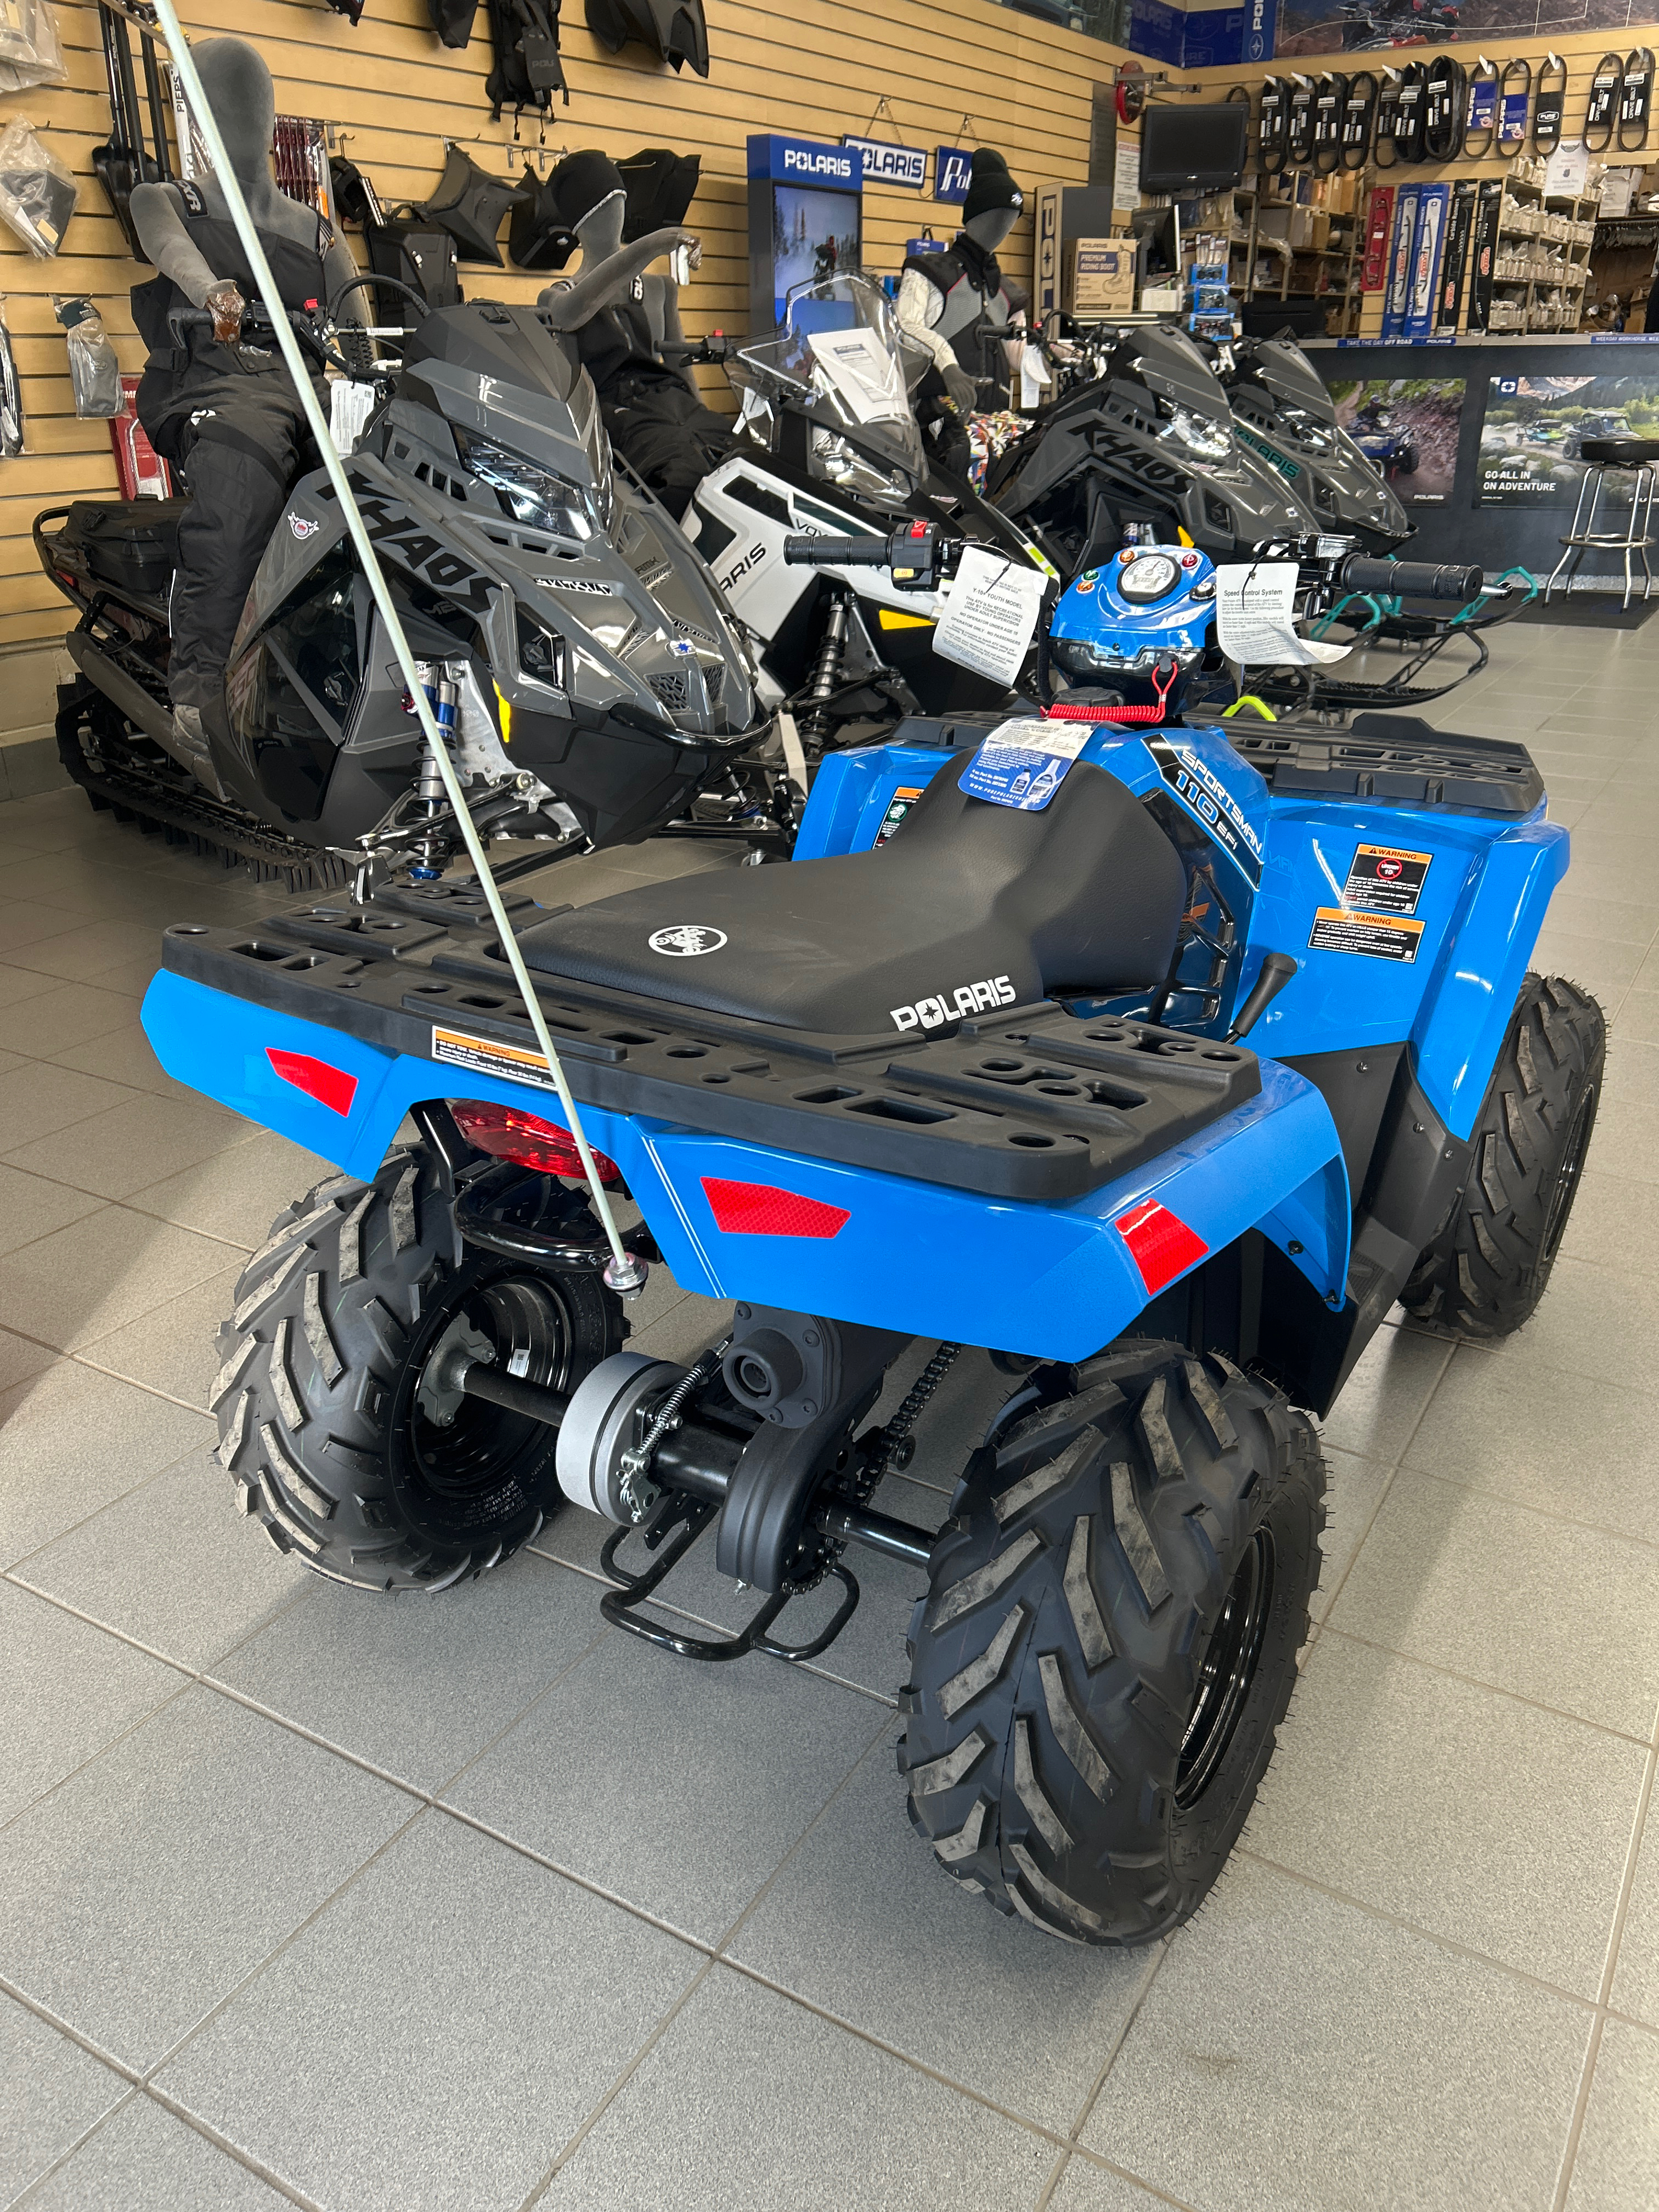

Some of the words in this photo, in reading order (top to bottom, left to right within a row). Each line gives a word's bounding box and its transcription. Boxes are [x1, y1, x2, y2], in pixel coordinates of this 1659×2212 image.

[1498, 99, 1506, 138] POLARIS
[784, 149, 851, 177] POLARIS
[862, 148, 923, 179] OLARIS
[1485, 471, 1498, 479] GO
[1499, 471, 1519, 479] ALL
[1483, 482, 1497, 490] ON
[1498, 482, 1556, 492] ADVENTURE
[986, 592, 1005, 602] YOUTH
[1005, 599, 1023, 609] MODEL
[963, 604, 978, 613] UNDER
[992, 614, 1019, 627] SUPERVISION
[966, 614, 989, 625] OPERATOR
[993, 606, 1023, 619] RECREATIONAL
[997, 611, 1021, 623] OPERATORS
[950, 616, 973, 628] OPERATOR
[994, 633, 1020, 646] PASSENGERS
[1176, 769, 1220, 825] 110
[1216, 821, 1238, 850] EFI
[1181, 748, 1262, 854] SPORTSMAN
[1378, 848, 1417, 860] WARNING
[1353, 913, 1391, 925] WARNING
[890, 975, 1016, 1032] POLARIS
[483, 1045, 510, 1057] WARNING
